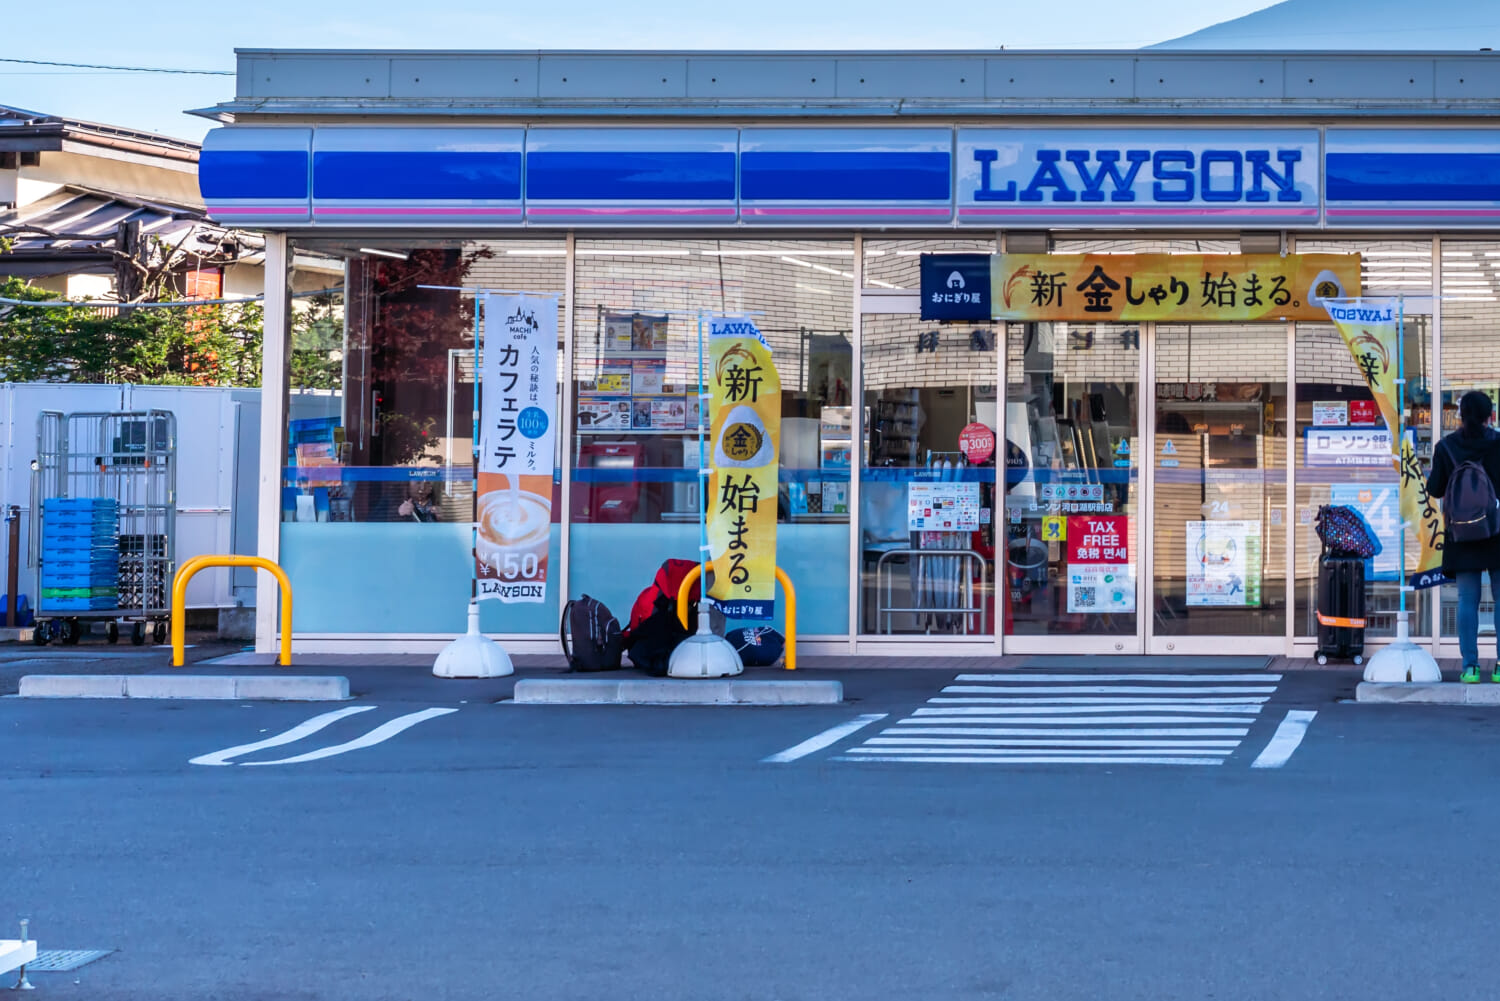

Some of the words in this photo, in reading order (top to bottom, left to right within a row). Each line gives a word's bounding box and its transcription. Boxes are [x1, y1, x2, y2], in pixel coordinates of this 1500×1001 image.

[973, 149, 1303, 202] LAWSON
[1030, 270, 1067, 308] 新
[1075, 264, 1190, 313] 金しゃり
[931, 292, 981, 304] おにぎり屋
[509, 326, 532, 335] MACHI
[725, 364, 764, 403] 新
[494, 344, 519, 469] カフェラテ
[969, 439, 988, 450] 300
[1317, 435, 1391, 450] ローソン銀
[1211, 500, 1229, 513] 24
[720, 474, 761, 593] 始まる。
[1087, 520, 1115, 533] TAX
[1082, 534, 1120, 547] FREE
[1077, 547, 1100, 560] 免税
[1103, 547, 1127, 560] 면세
[481, 582, 543, 598] LAWSON
